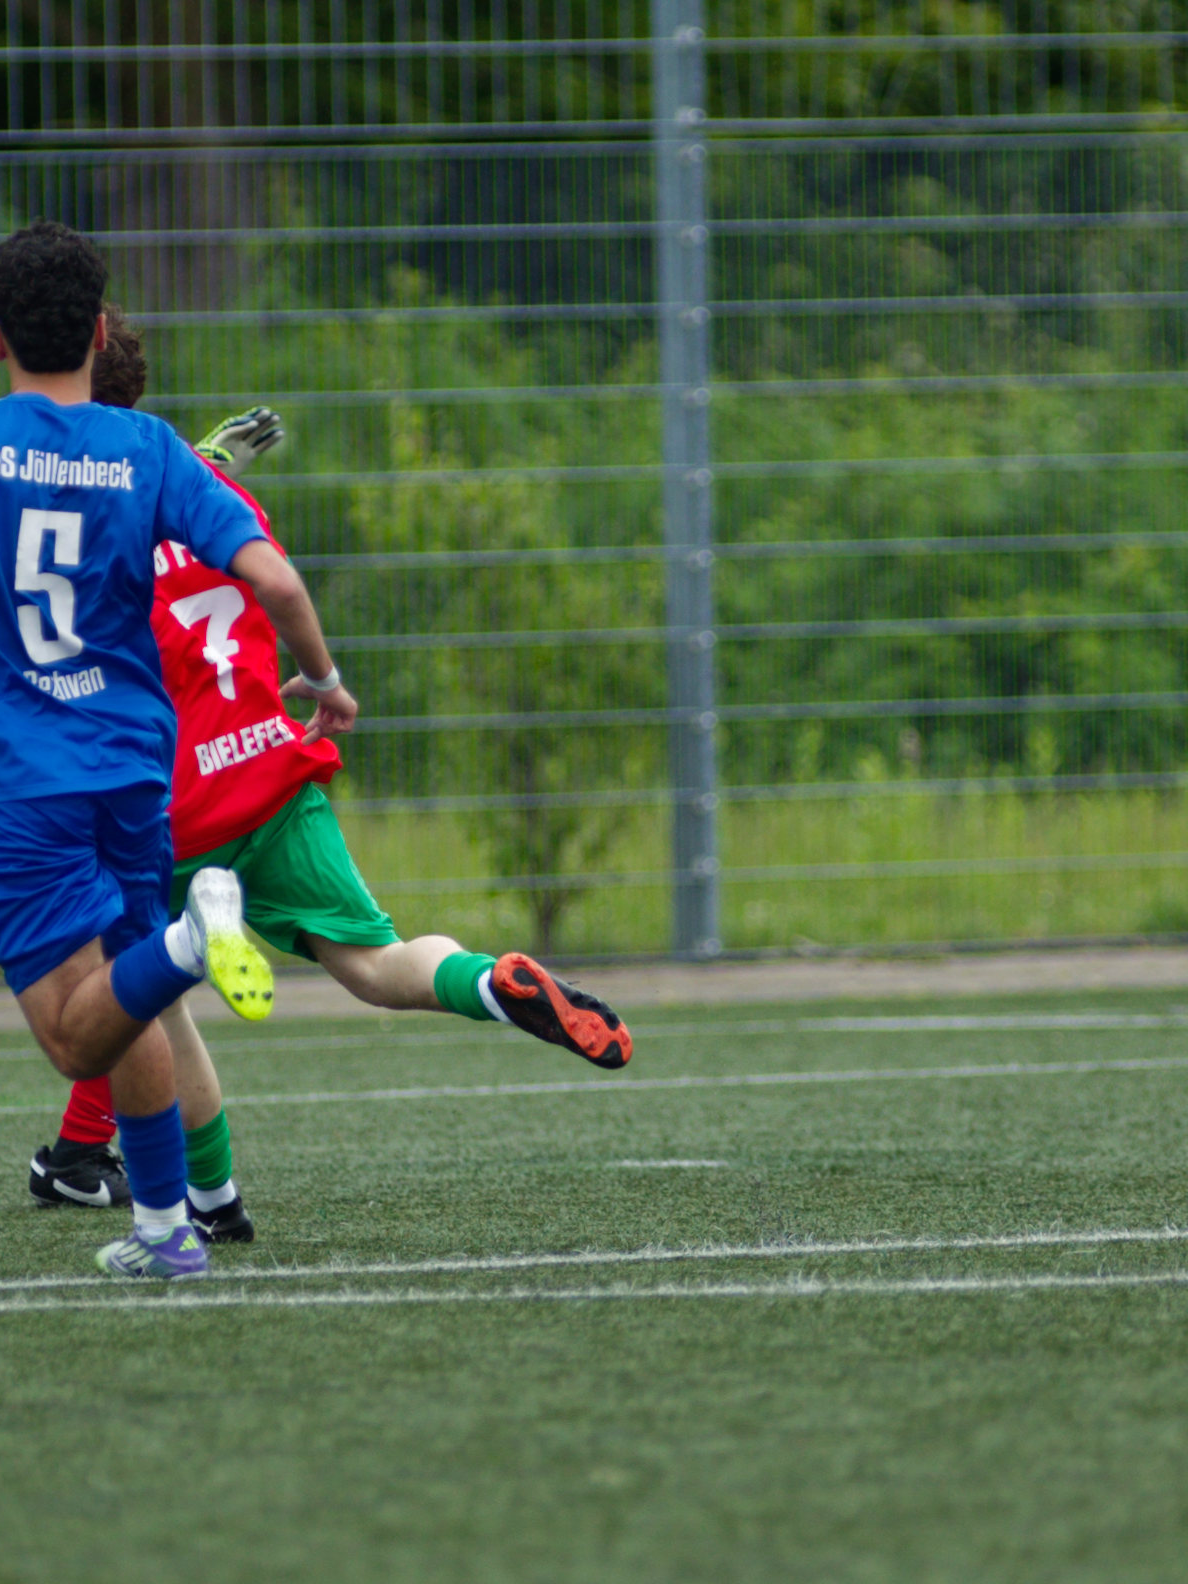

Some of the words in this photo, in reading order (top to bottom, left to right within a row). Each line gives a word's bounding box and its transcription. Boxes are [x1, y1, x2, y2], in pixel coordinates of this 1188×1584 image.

[19, 448, 135, 491] Jöllenbeck
[14, 507, 83, 664] 5
[169, 584, 246, 701] 7
